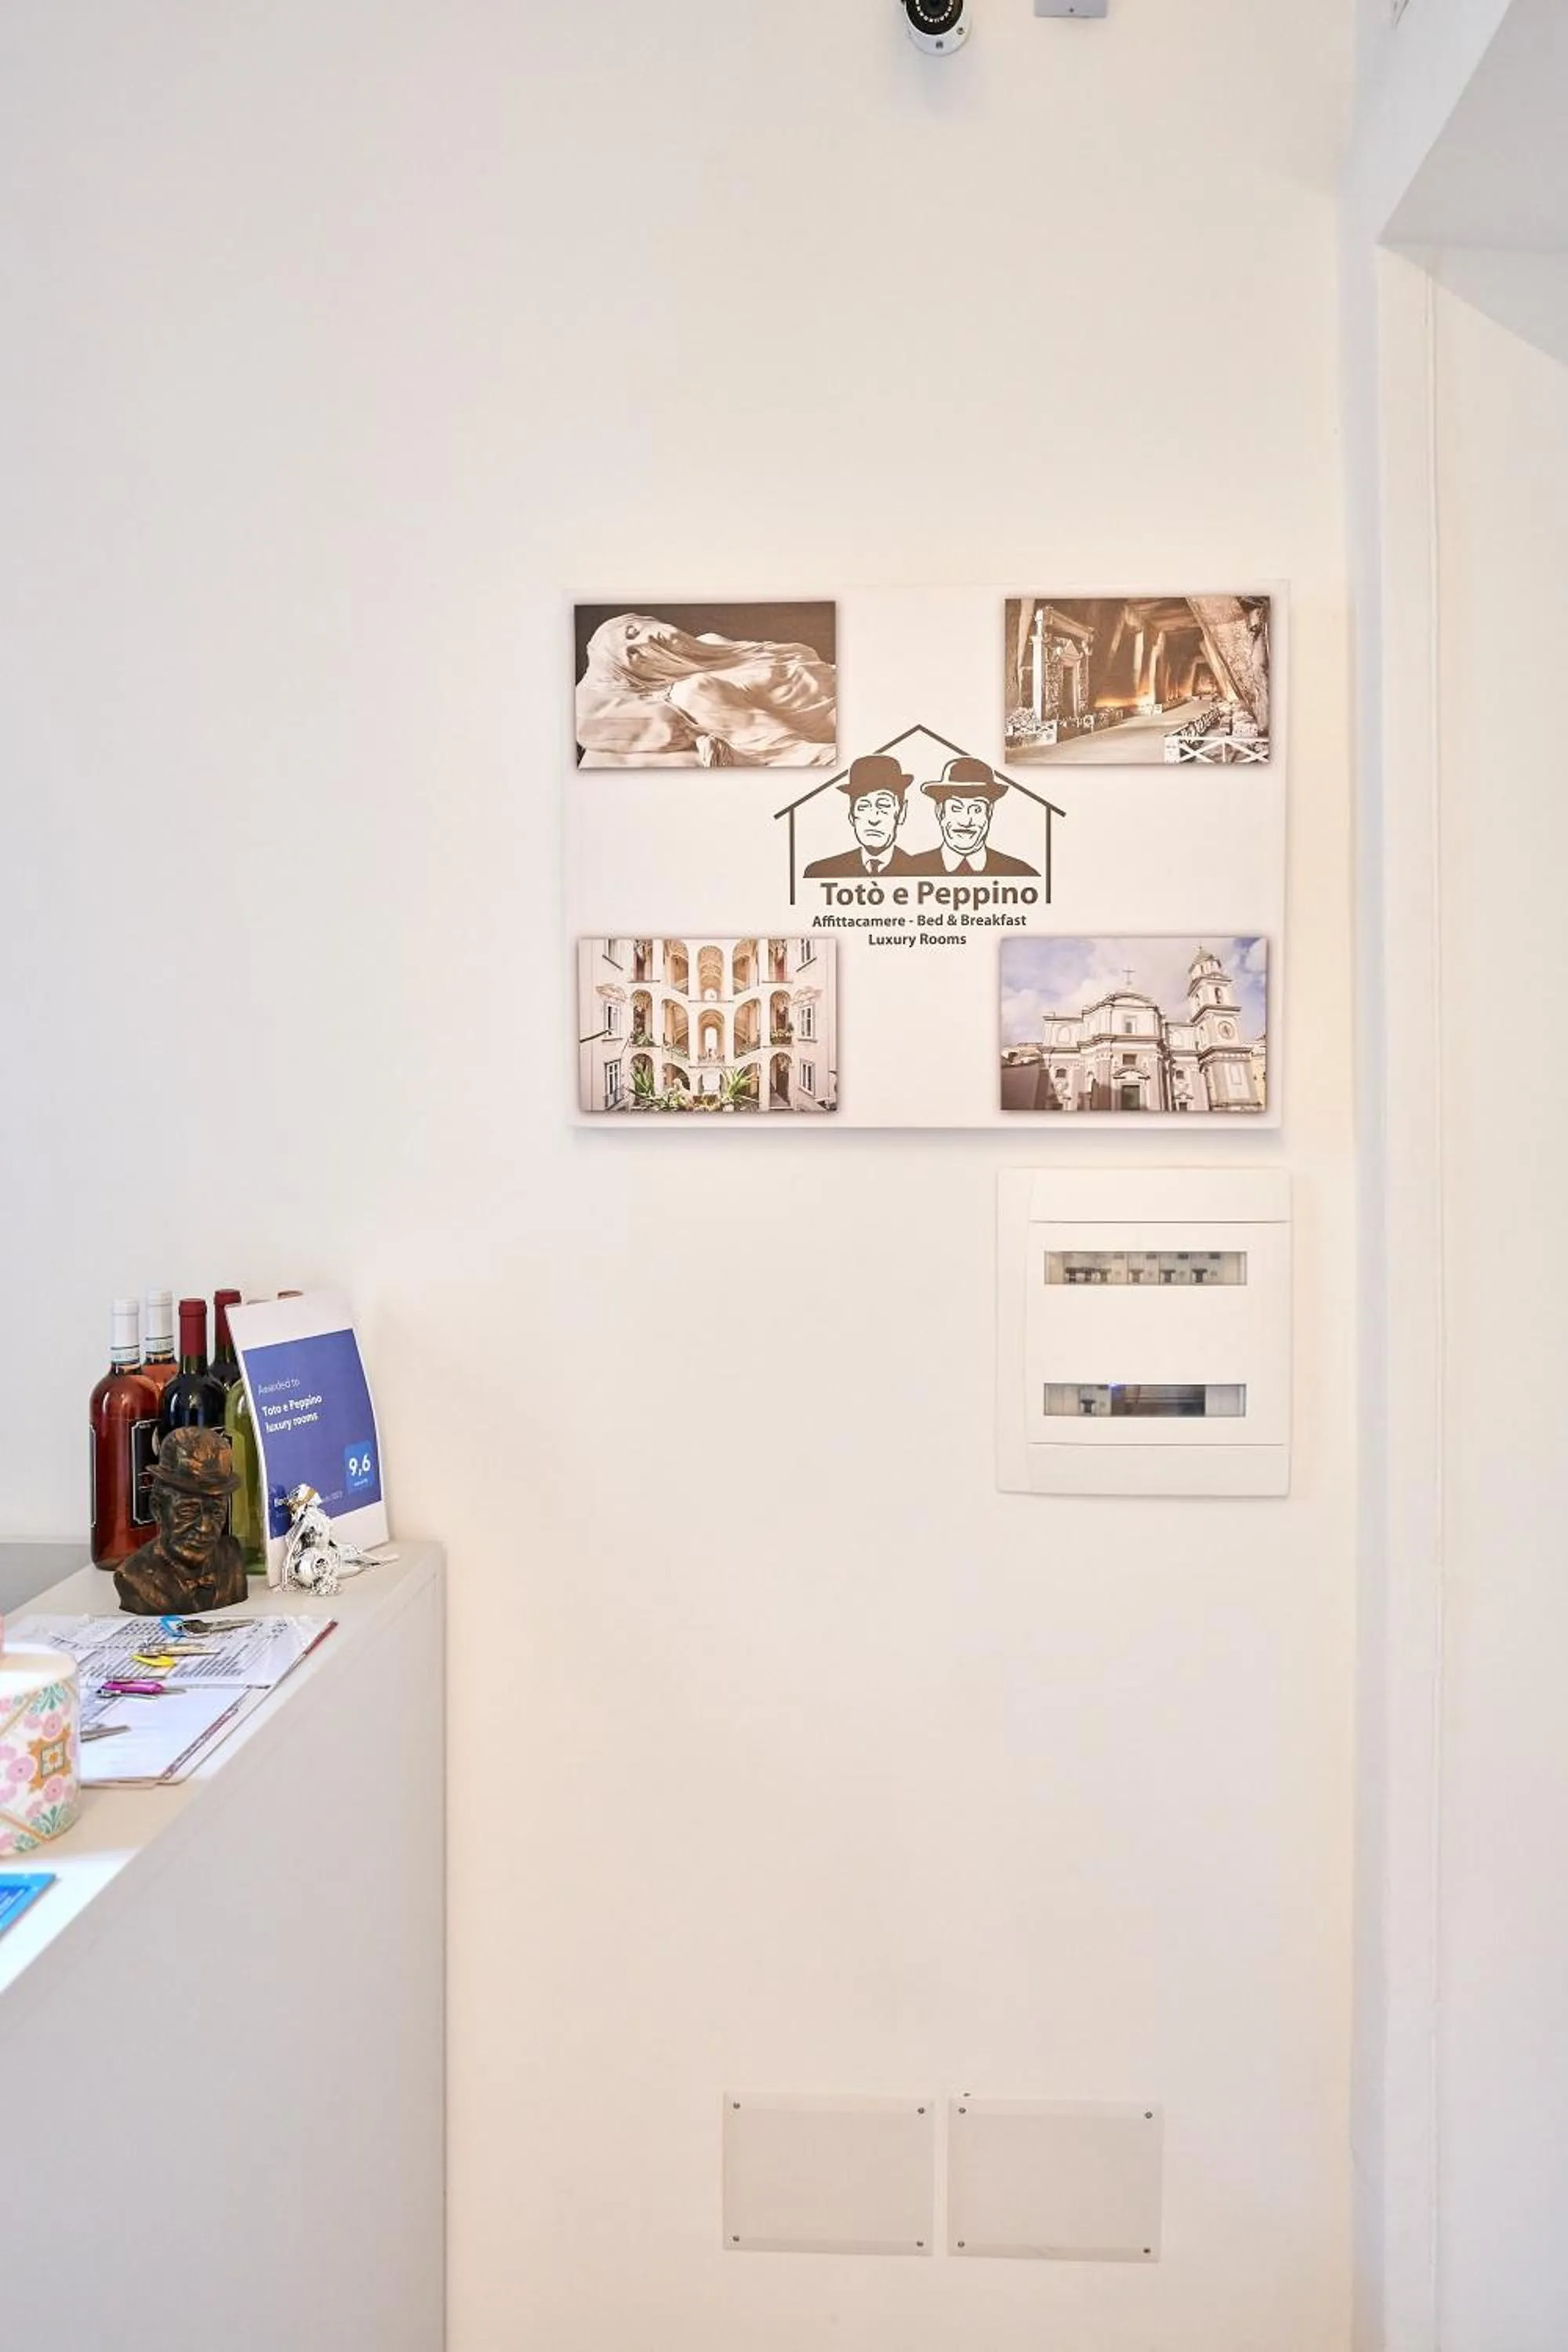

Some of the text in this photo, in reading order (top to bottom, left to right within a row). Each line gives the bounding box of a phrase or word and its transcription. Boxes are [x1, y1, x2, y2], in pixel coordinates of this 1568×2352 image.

[820, 880, 1039, 910] Totò e Peppino
[812, 915, 906, 927] Affittacamere
[917, 914, 943, 926] Bed
[947, 914, 957, 926] &
[960, 914, 1026, 926] Breakfast
[869, 933, 967, 947] Luxury Rooms
[289, 1394, 322, 1410] Peppino
[265, 1412, 318, 1433] luxury rooms
[349, 1453, 371, 1476] 9,6
